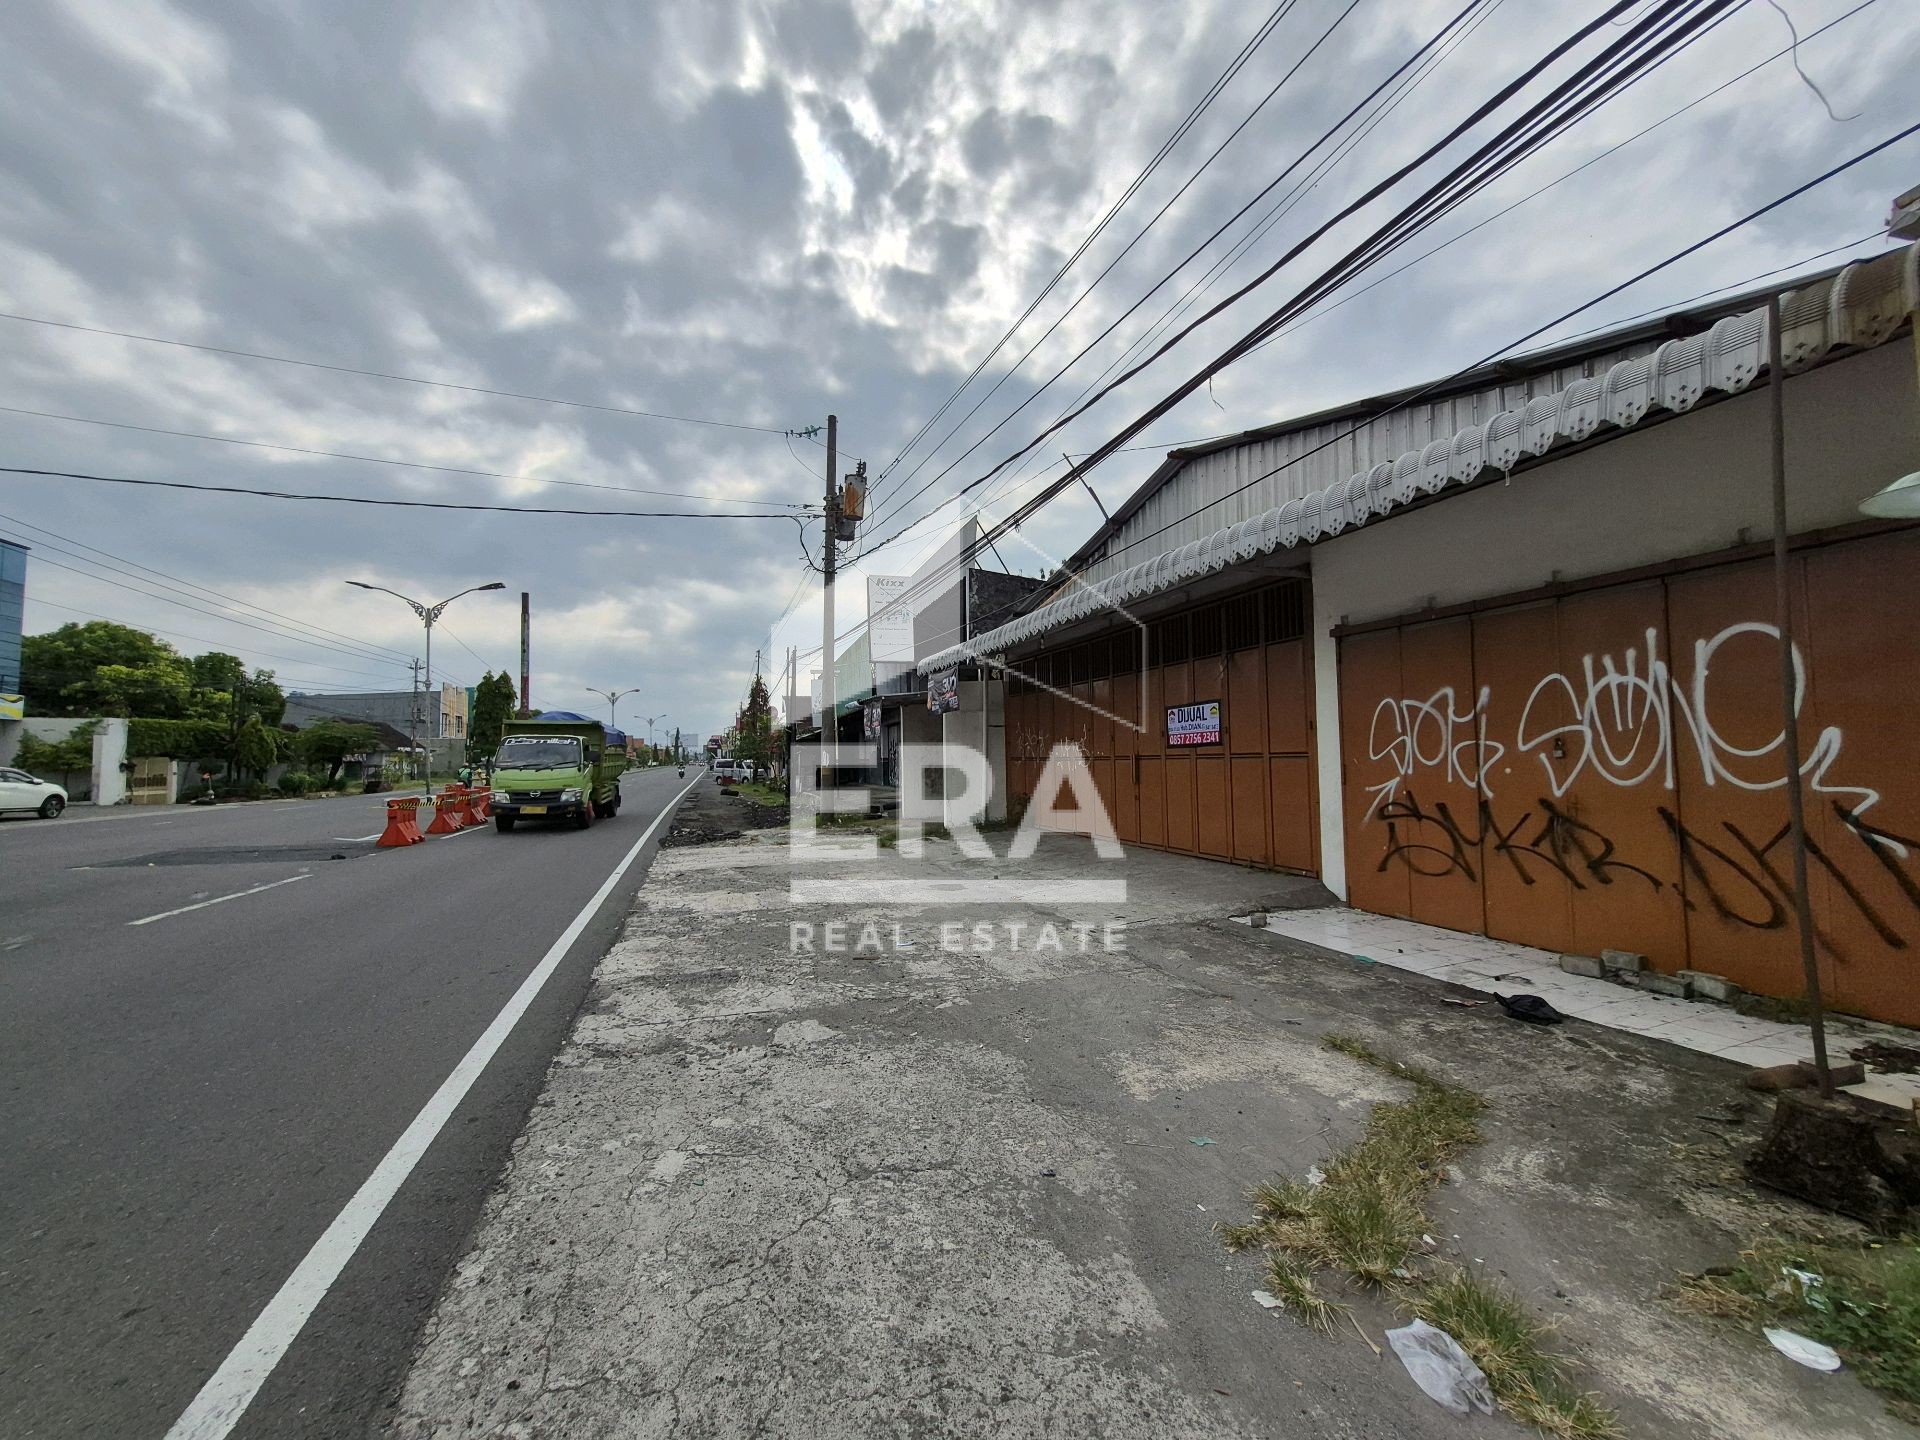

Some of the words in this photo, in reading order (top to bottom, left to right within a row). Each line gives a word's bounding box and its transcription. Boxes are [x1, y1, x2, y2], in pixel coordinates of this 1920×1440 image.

[876, 578, 905, 588] Kixx
[1177, 706, 1207, 723] DIJUAL
[1169, 734, 1184, 745] 0857
[1185, 733, 1202, 744] 2756
[1202, 731, 1219, 743] 2341
